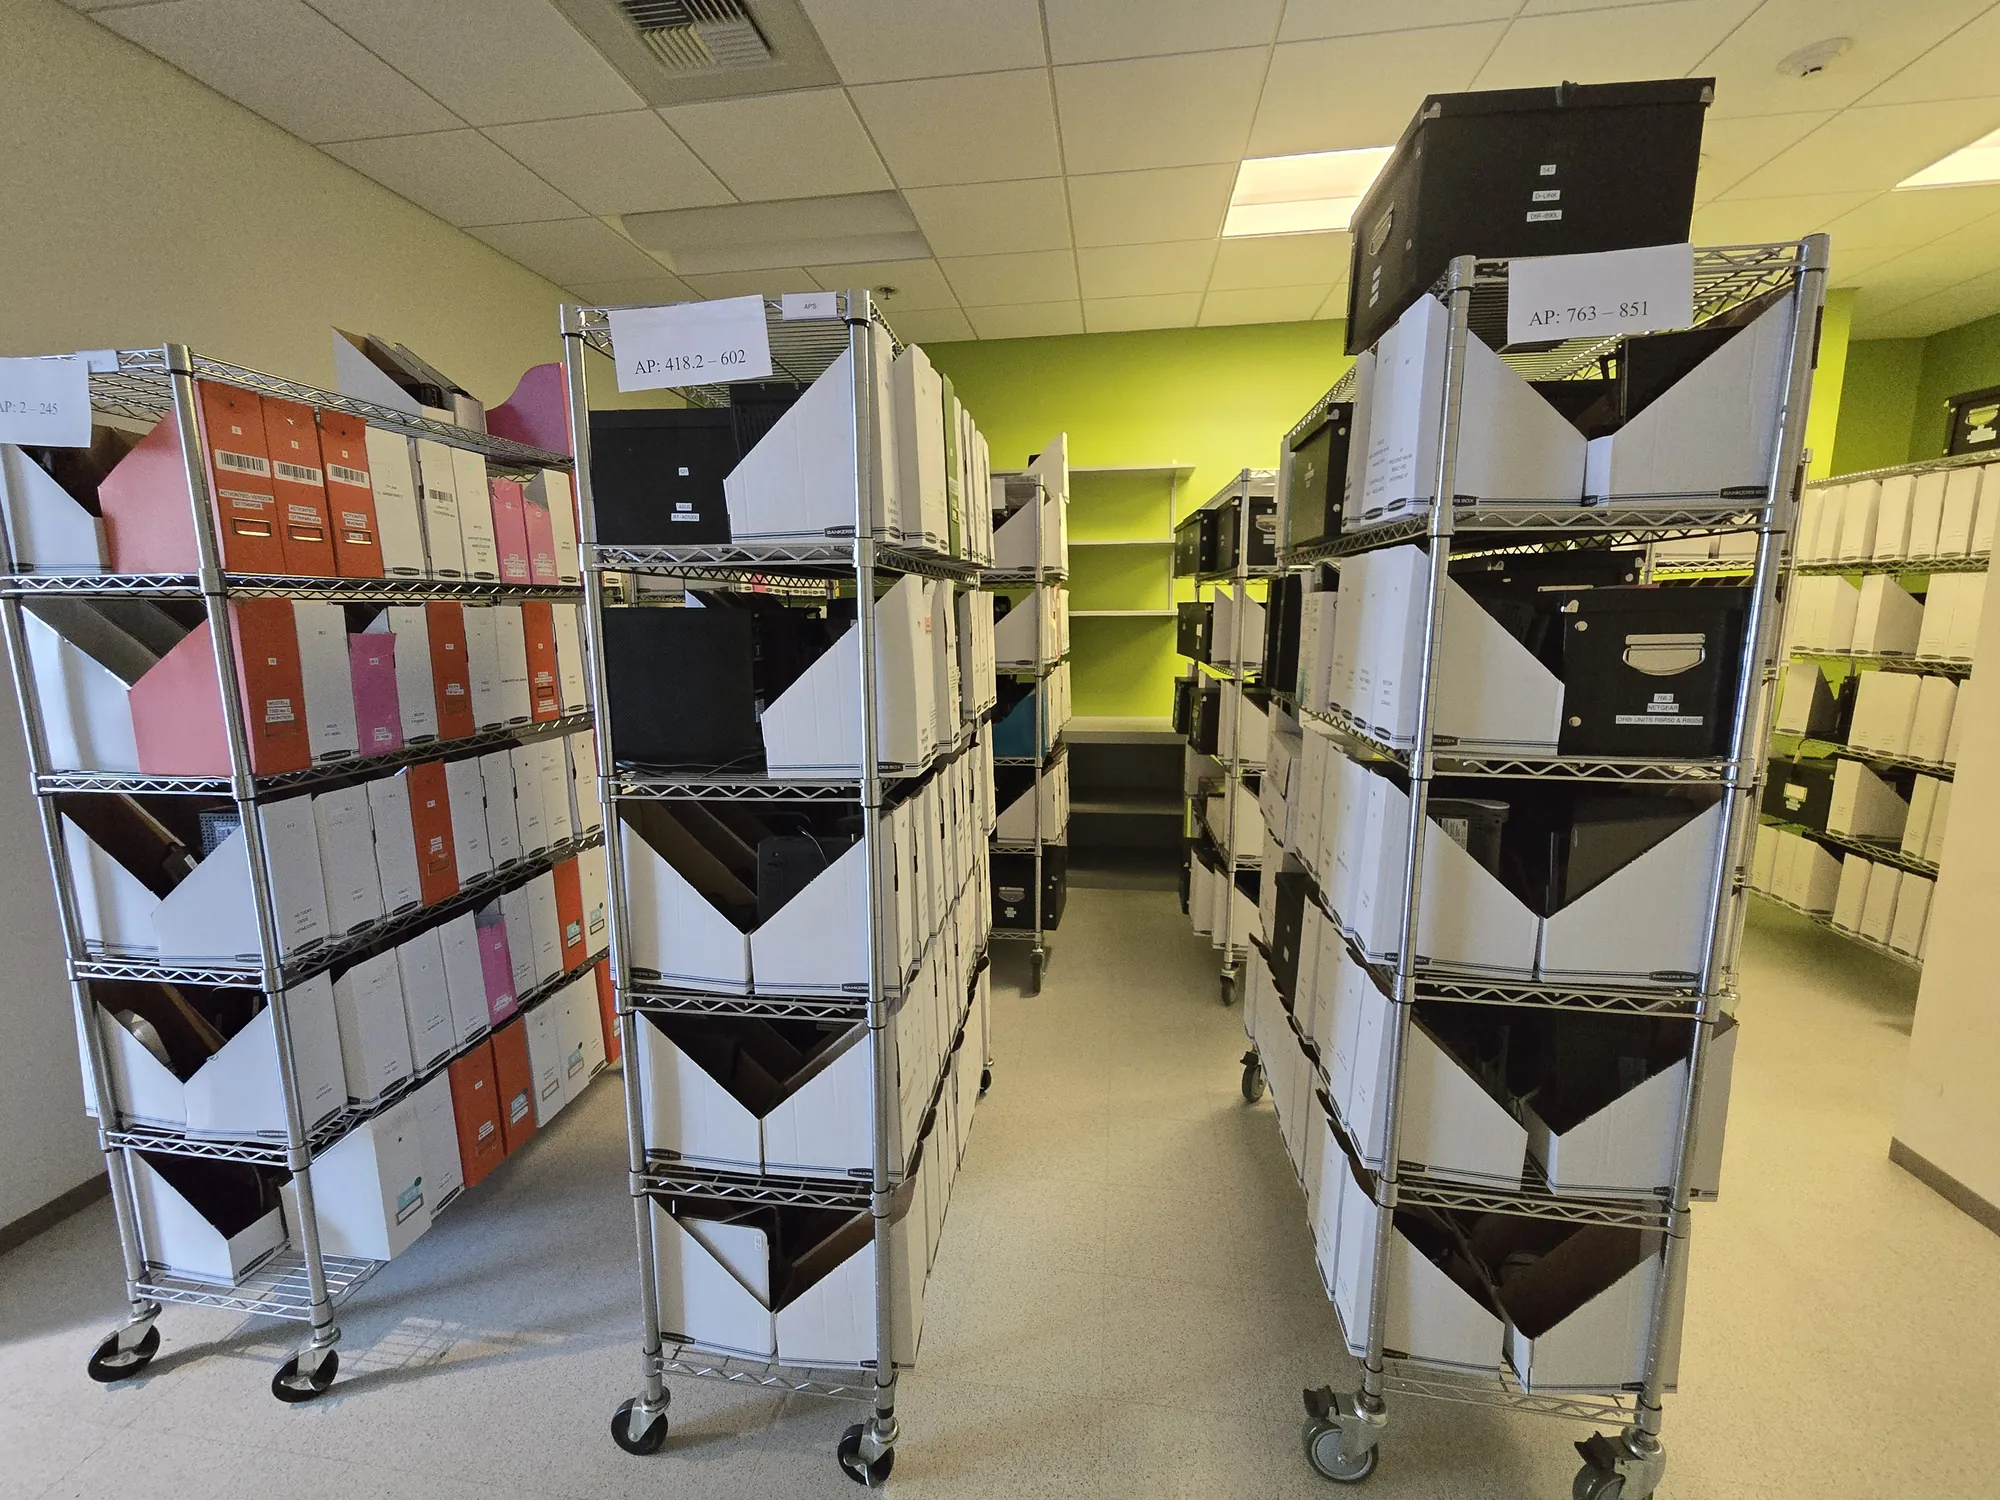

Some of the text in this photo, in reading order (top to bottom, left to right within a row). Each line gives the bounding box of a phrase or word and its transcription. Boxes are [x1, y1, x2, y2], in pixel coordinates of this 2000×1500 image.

[1528, 310, 1560, 327] AP:
[1566, 305, 1597, 323] 763
[1619, 301, 1649, 318] 851
[634, 361, 662, 375] AP:
[665, 354, 704, 371] 418.2
[720, 349, 746, 366] 602
[19, 401, 27, 414] 2
[39, 403, 58, 415] 245
